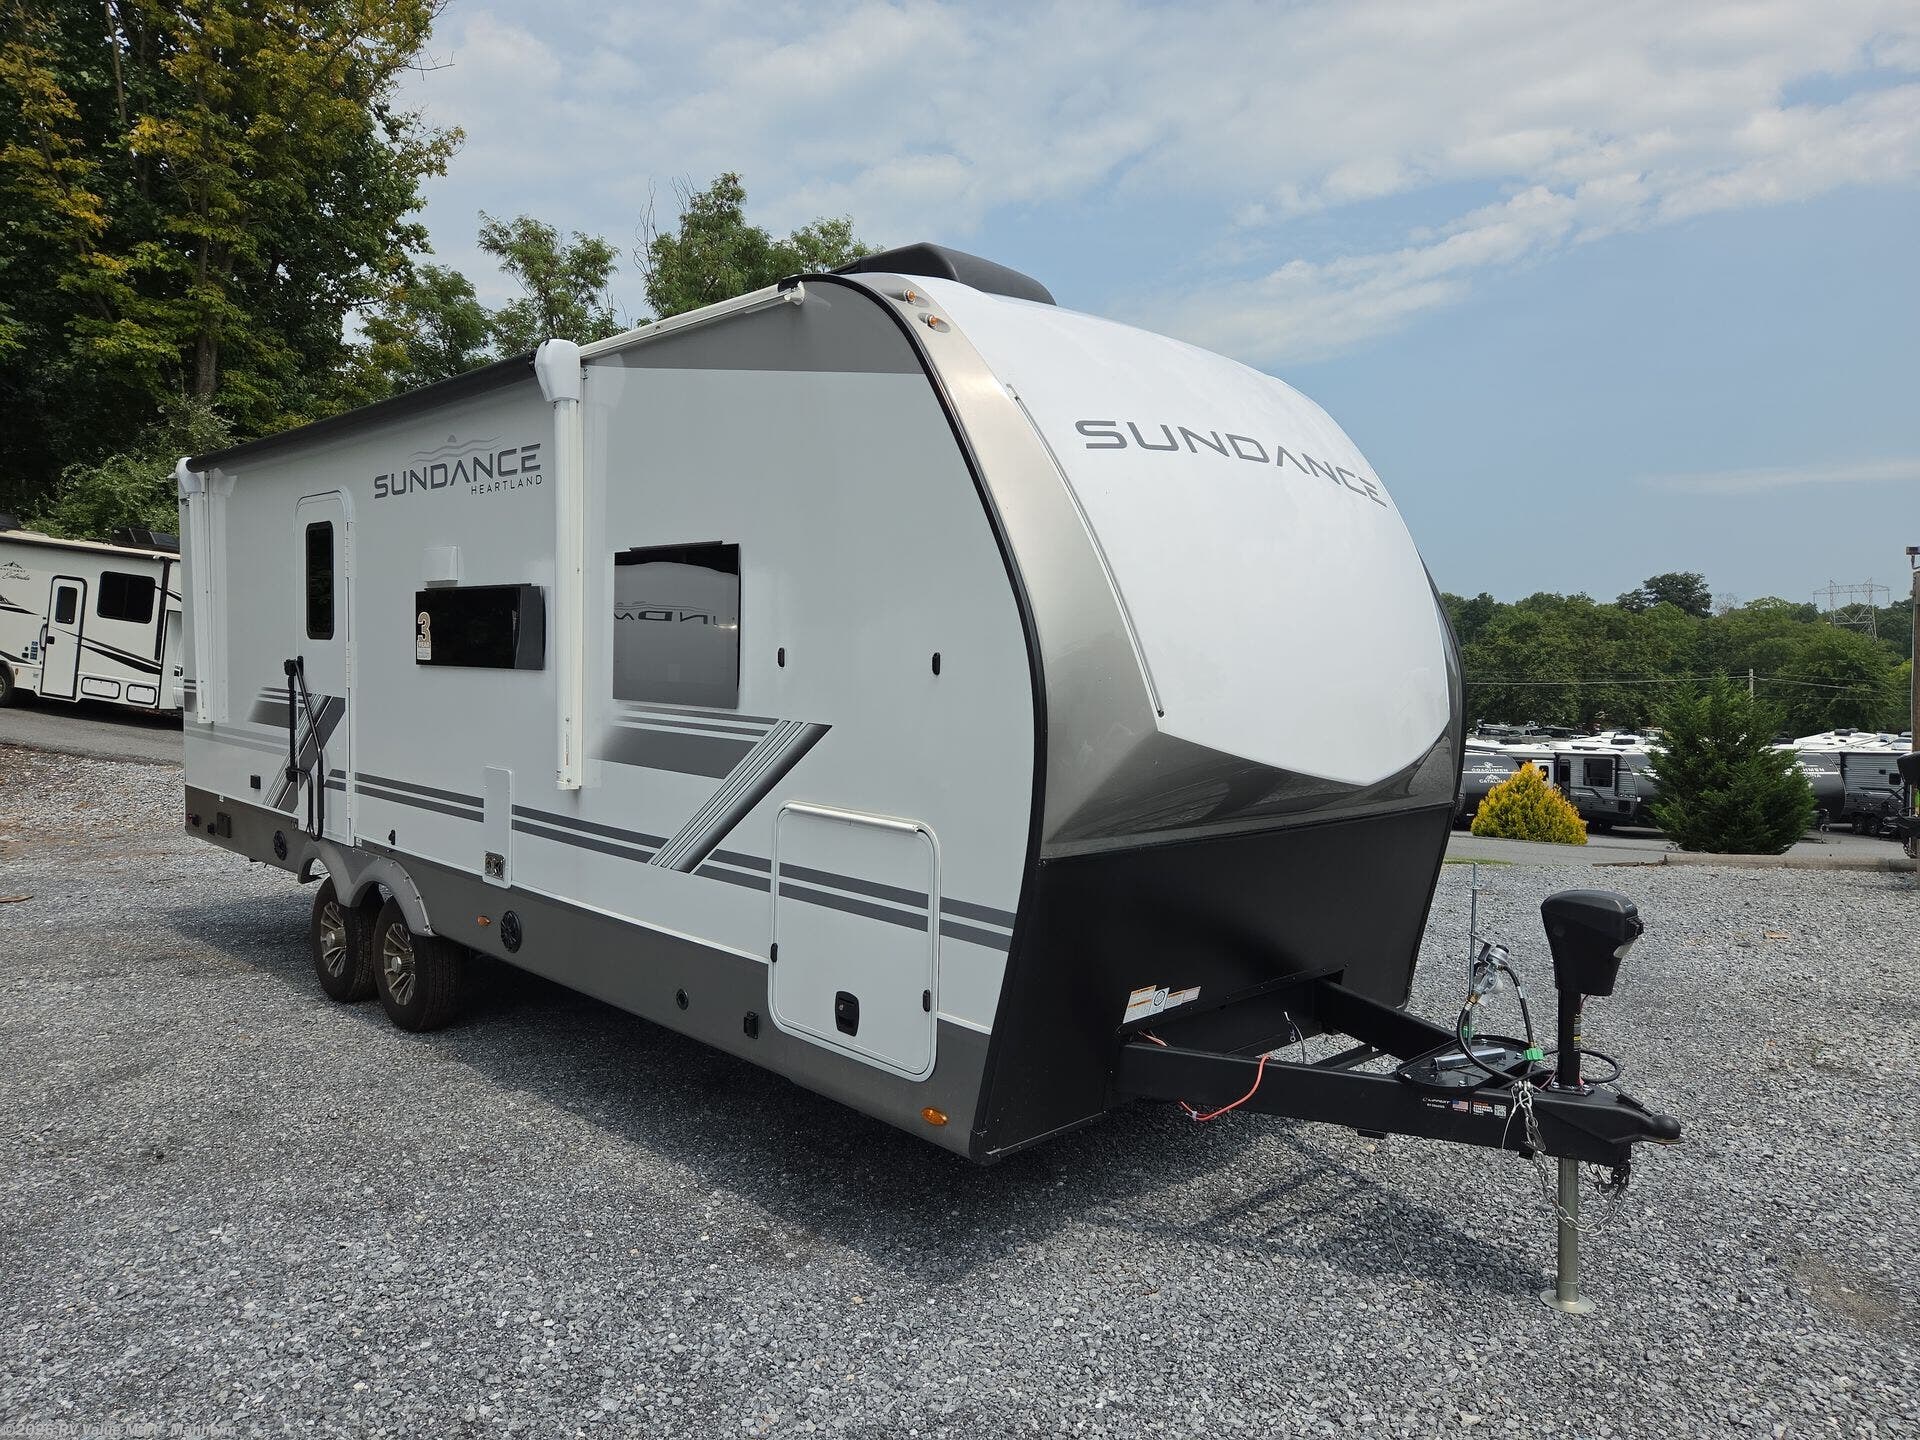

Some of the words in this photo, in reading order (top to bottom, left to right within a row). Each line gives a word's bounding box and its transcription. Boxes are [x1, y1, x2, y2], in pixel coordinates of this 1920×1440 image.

[374, 443, 541, 499] SUNDANCE
[471, 474, 543, 495] HEARTLAND
[1075, 419, 1388, 508] SUNDANCE
[417, 611, 431, 641] 3
